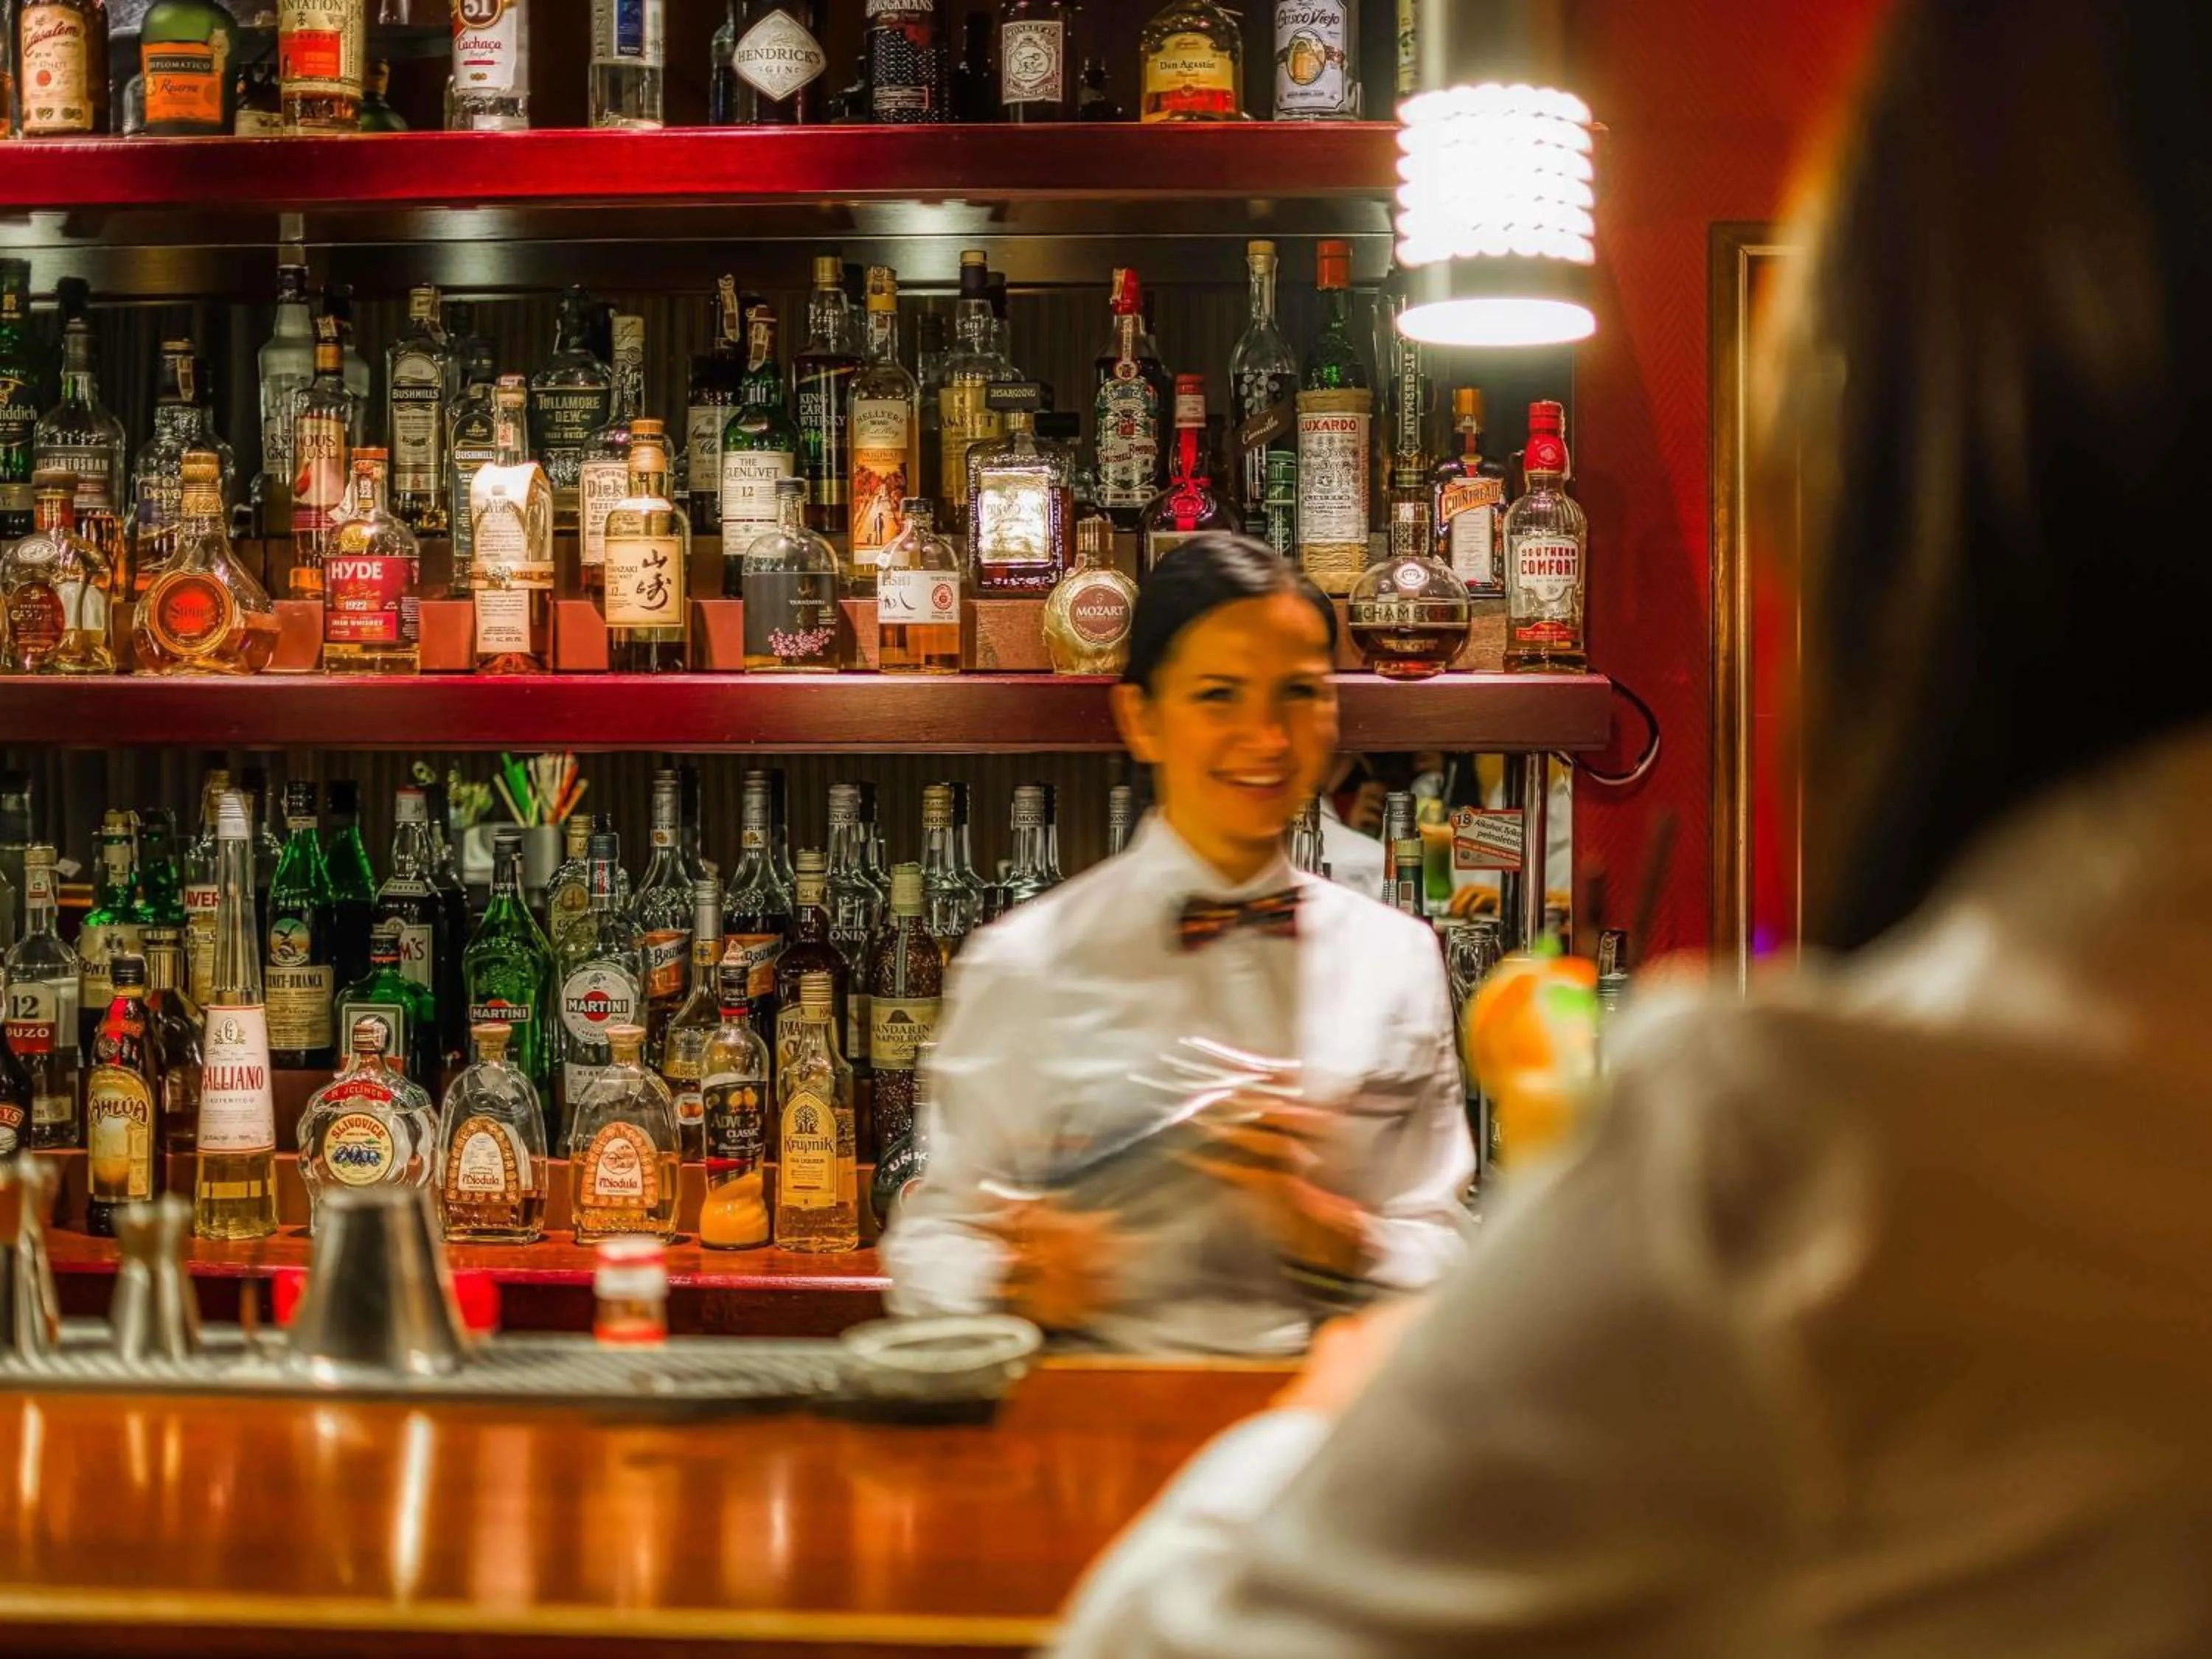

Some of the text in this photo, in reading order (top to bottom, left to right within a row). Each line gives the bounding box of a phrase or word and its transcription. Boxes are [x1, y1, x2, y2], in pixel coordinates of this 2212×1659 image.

[536, 393, 600, 410] TULLAMORE
[554, 411, 582, 422] DEW
[1302, 420, 1357, 431] LUXARDO
[739, 458, 758, 467] THE
[742, 486, 754, 497] 12
[1521, 546, 1576, 557] SOUTHERN
[331, 561, 383, 580] HYDE
[1520, 560, 1577, 576] COMFORT
[1076, 604, 1124, 617] MOZART
[10, 995, 39, 1019] 12
[472, 1006, 528, 1019] MARTINI
[568, 999, 627, 1014] MARTINI
[331, 1116, 386, 1140] SLIVOVICE
